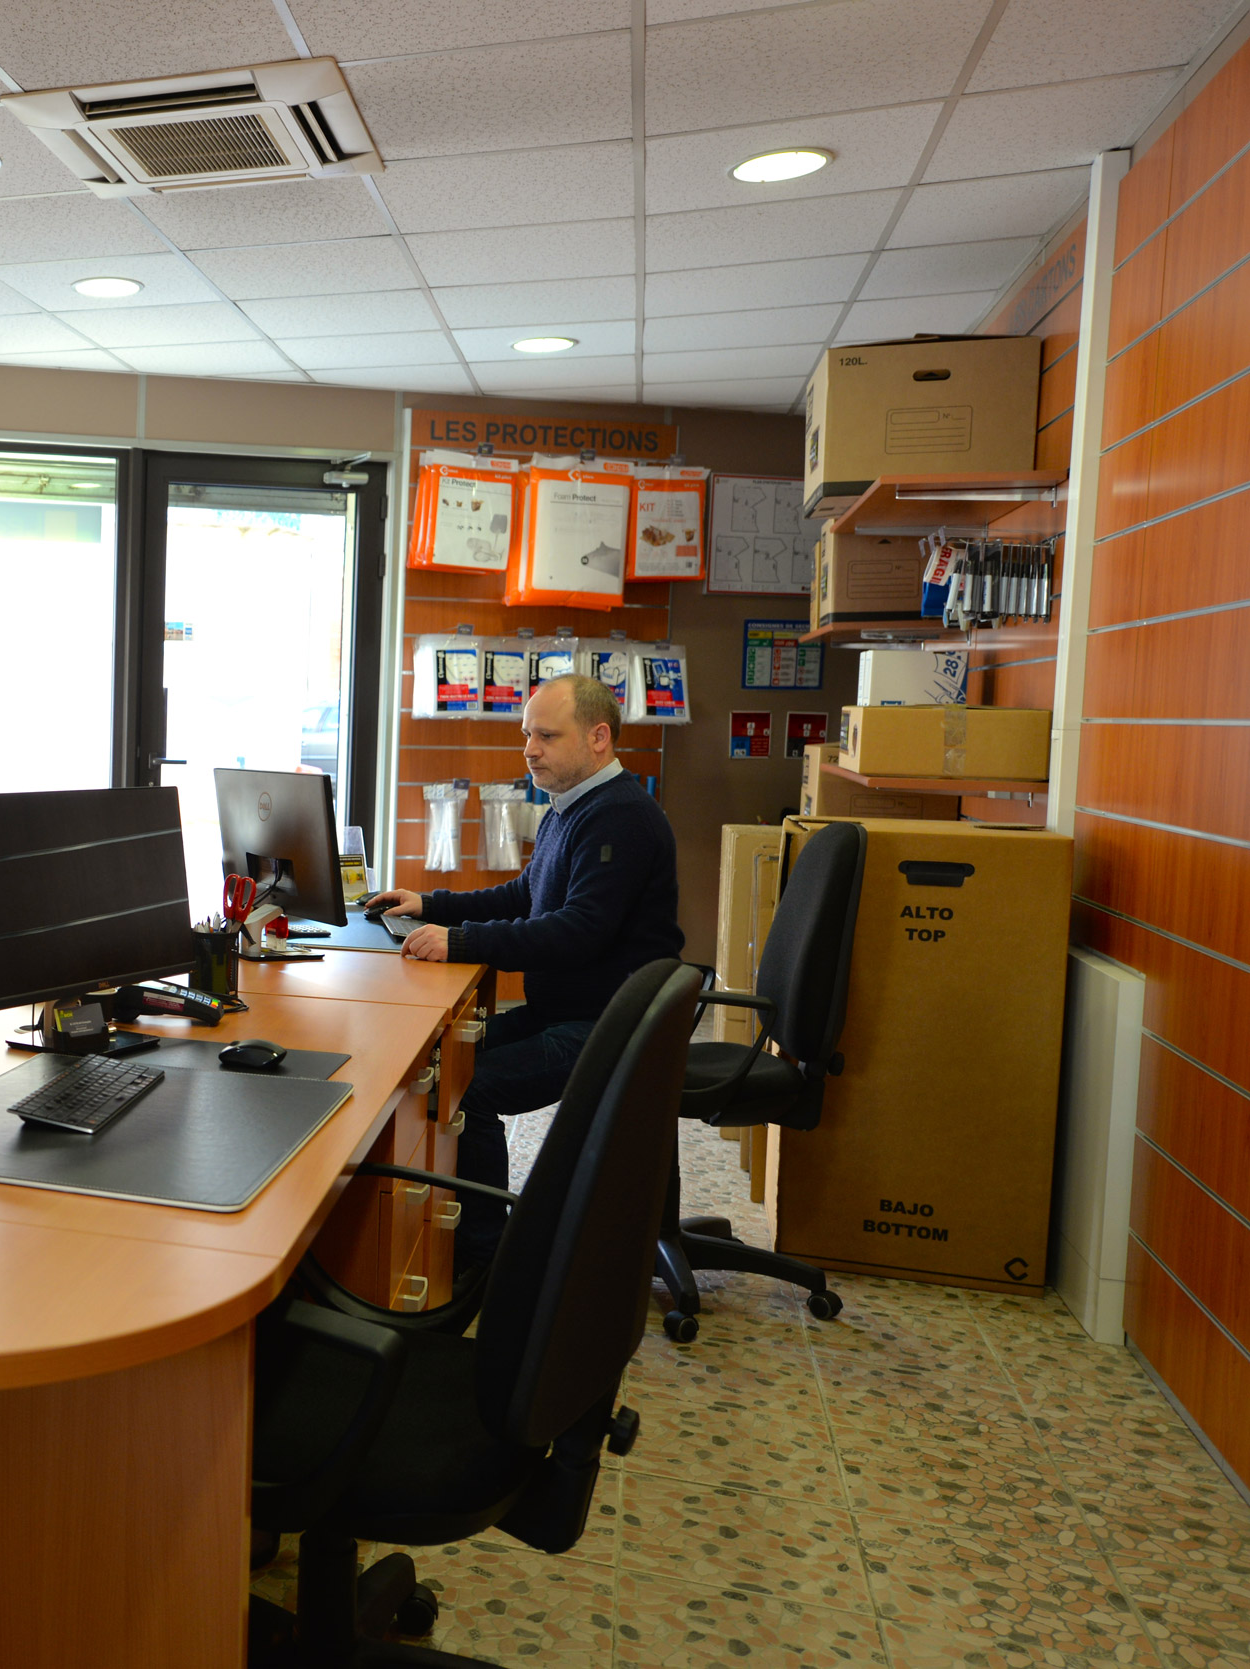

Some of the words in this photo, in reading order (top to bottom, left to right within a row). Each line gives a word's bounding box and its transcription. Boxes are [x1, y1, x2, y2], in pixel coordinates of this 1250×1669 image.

[429, 419, 477, 443] LES
[485, 421, 659, 453] PROTECTIONS
[572, 494, 596, 502] Protect
[639, 503, 655, 512] KIT
[900, 904, 954, 921] ALTO
[904, 927, 947, 943] TOP
[879, 1198, 935, 1218] BAJO
[863, 1219, 949, 1242] BOTTOM
